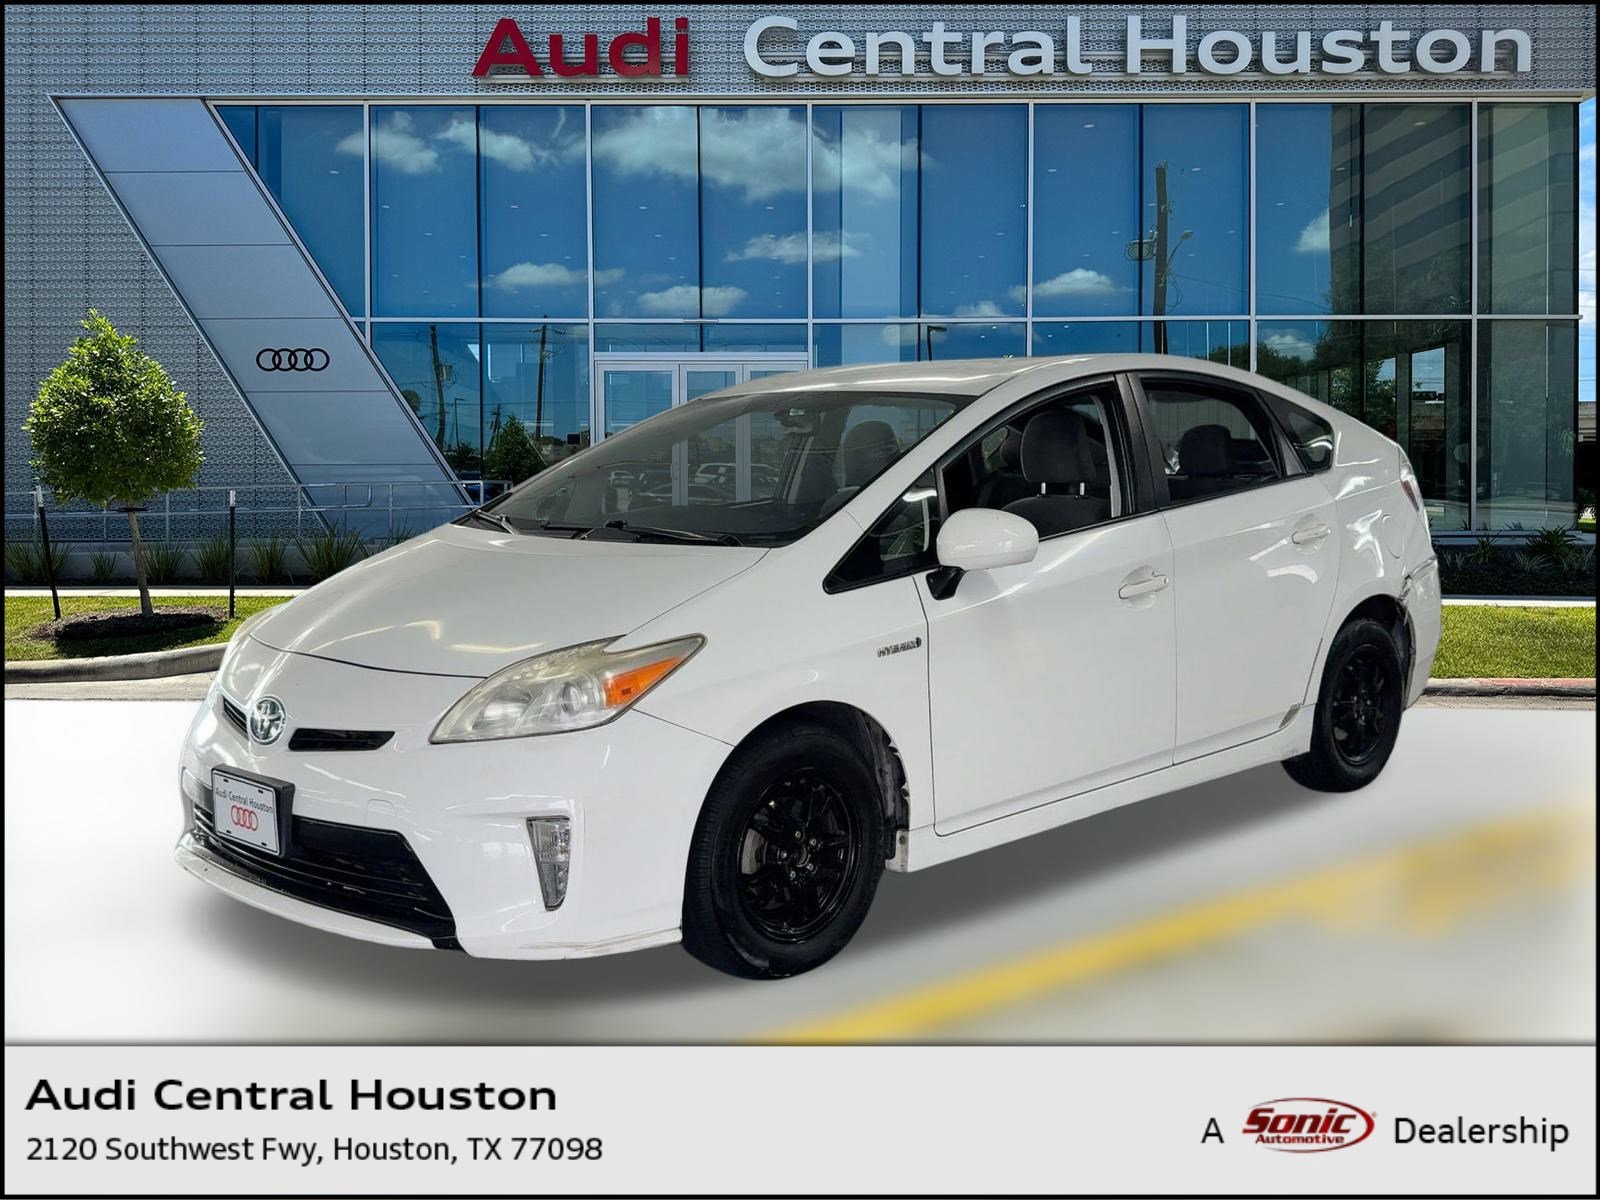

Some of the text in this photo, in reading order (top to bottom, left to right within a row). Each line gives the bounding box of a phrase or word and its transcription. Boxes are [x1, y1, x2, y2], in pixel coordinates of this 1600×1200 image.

[472, 15, 1532, 78] Audi Central Houston
